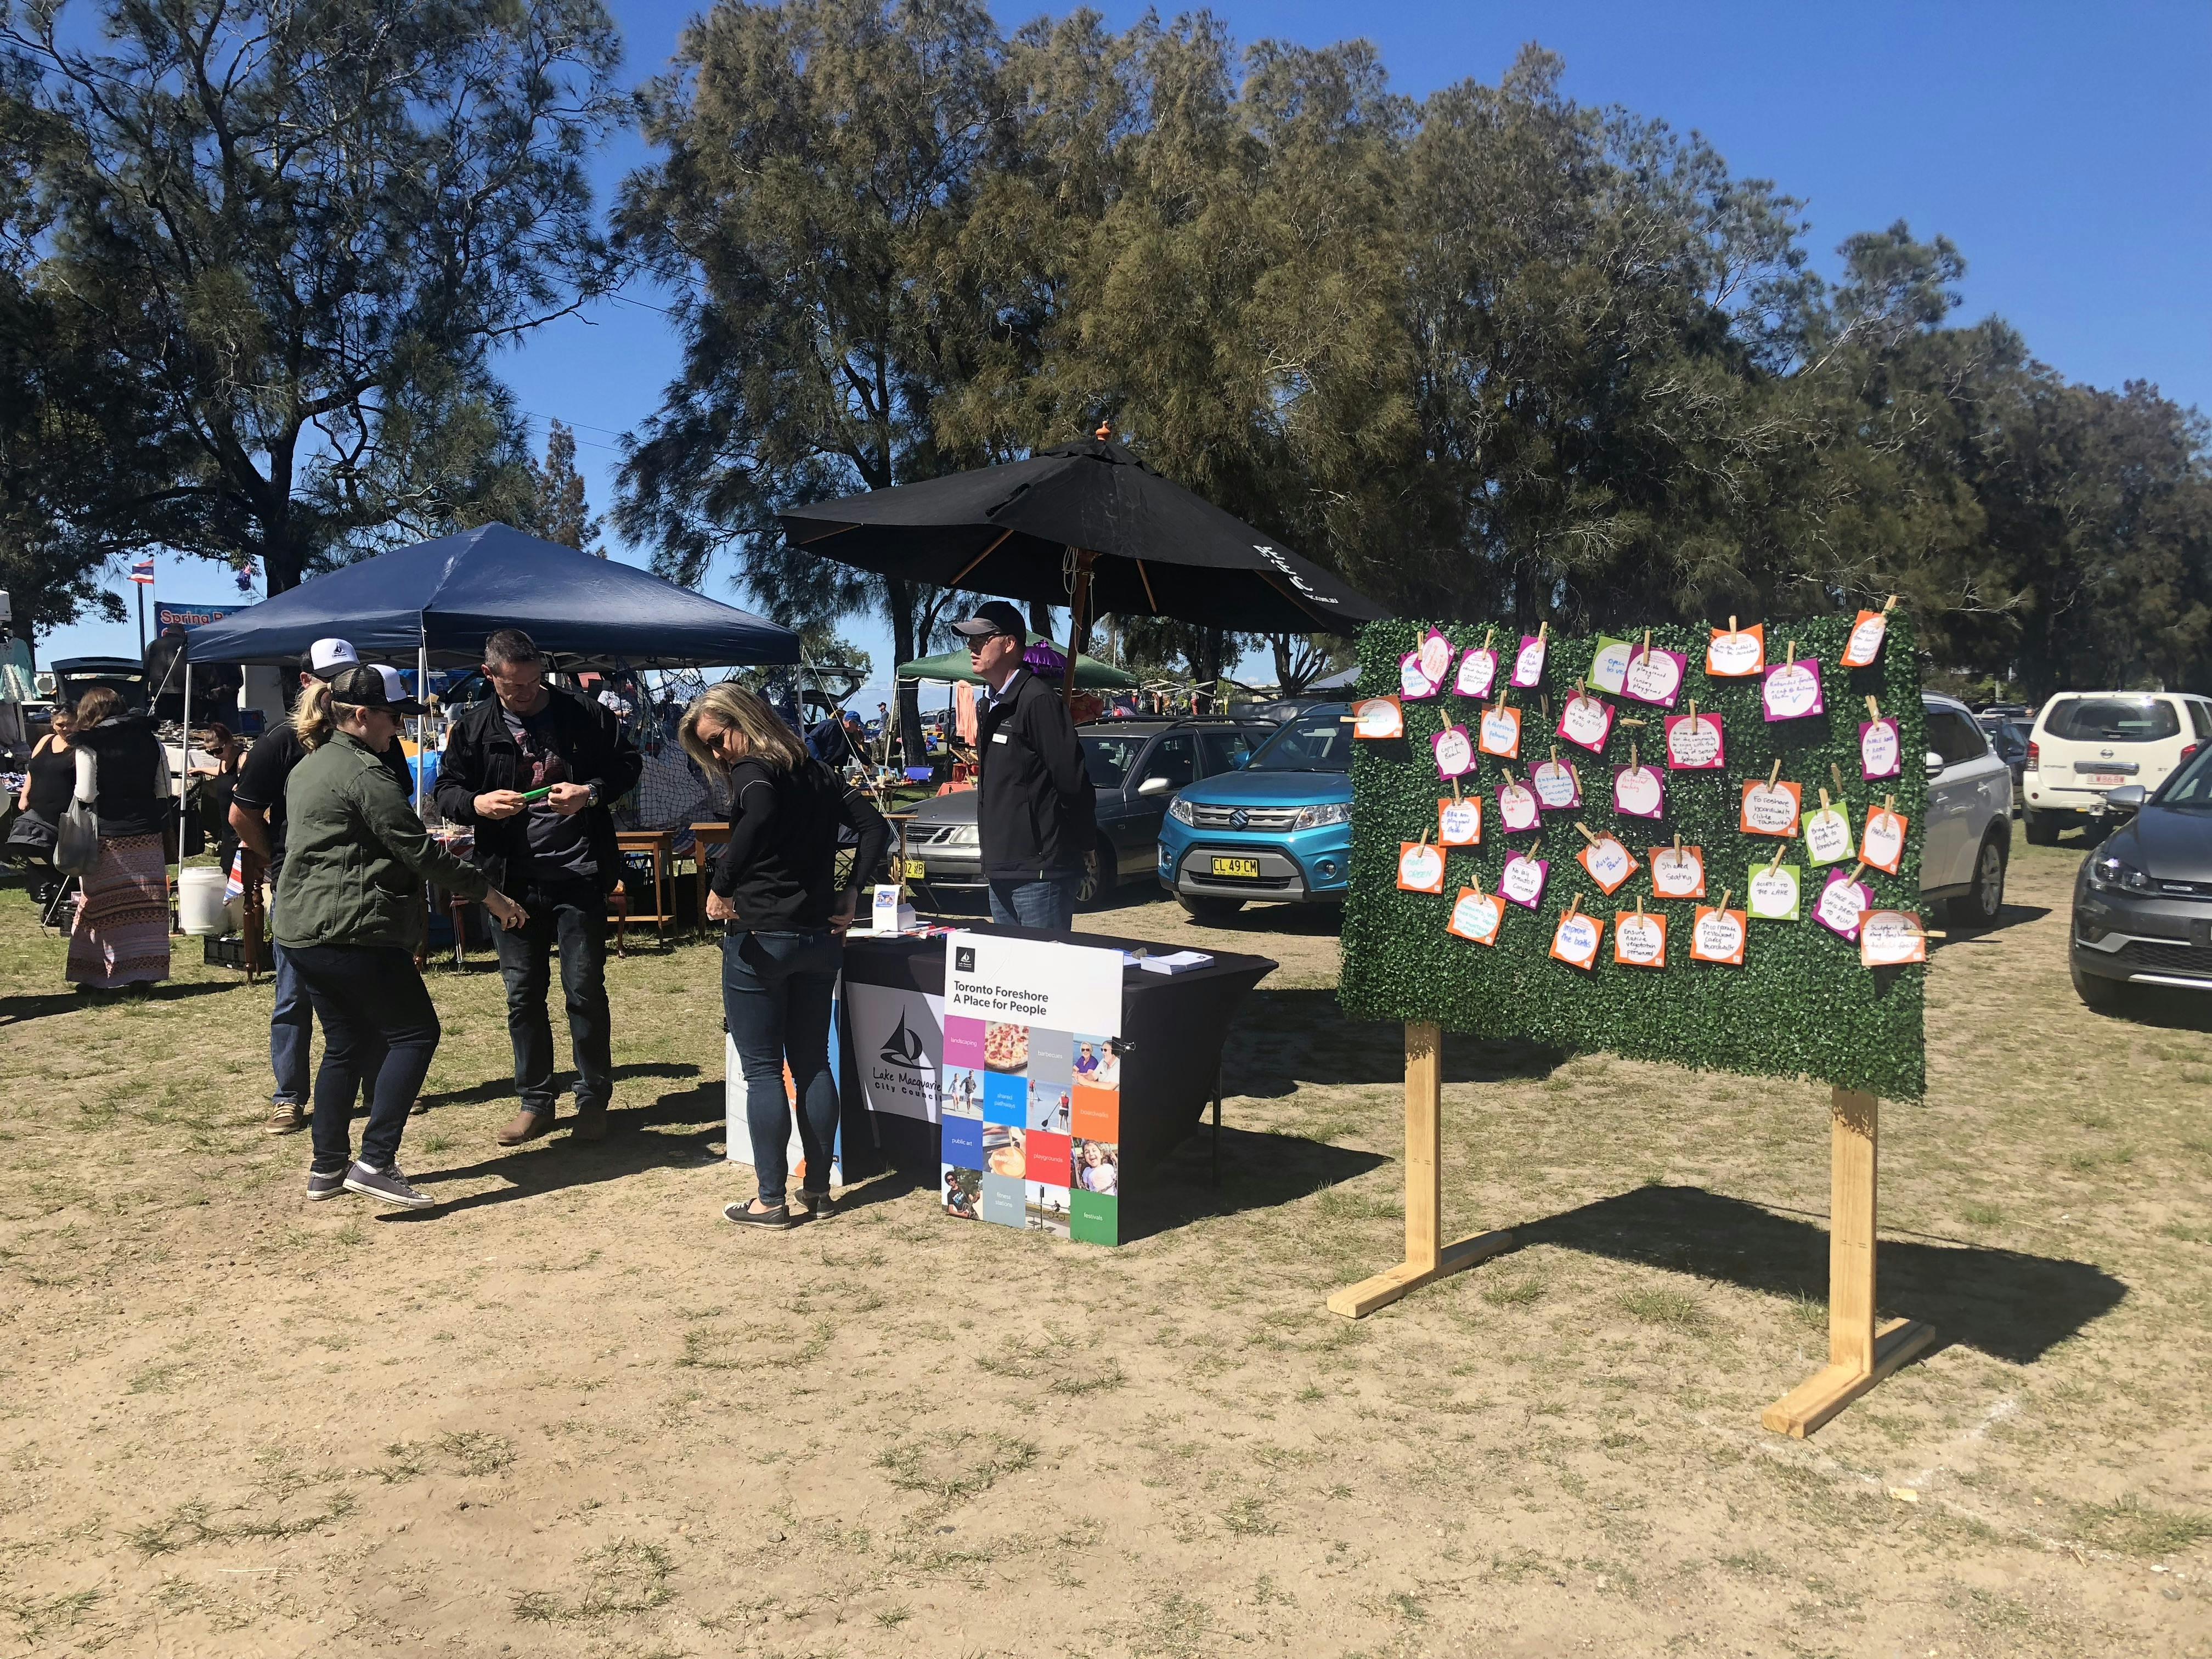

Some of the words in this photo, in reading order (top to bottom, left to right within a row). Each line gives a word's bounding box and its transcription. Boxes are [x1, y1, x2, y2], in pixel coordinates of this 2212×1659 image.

[161, 610, 210, 625] Spring
[954, 980, 993, 995] Toronto
[996, 986, 1048, 1002] Foreshore
[953, 994, 961, 1003] A
[964, 995, 990, 1007] Place
[993, 998, 1007, 1010] for
[1010, 1001, 1047, 1015] People
[951, 1037, 977, 1047] landscaping
[1038, 1050, 1063, 1059] barbecues
[873, 1066, 894, 1081] Lake
[899, 1072, 941, 1092] Macquarie
[874, 1082, 895, 1092] City
[901, 1087, 942, 1102] Council
[994, 1101, 1016, 1110] pathways
[1080, 1108, 1109, 1119] boardwalks
[1033, 1153, 1063, 1163] playgrounds
[996, 1192, 1012, 1200] fitness
[995, 1199, 1013, 1207] stations
[1084, 1211, 1103, 1221] festivals
